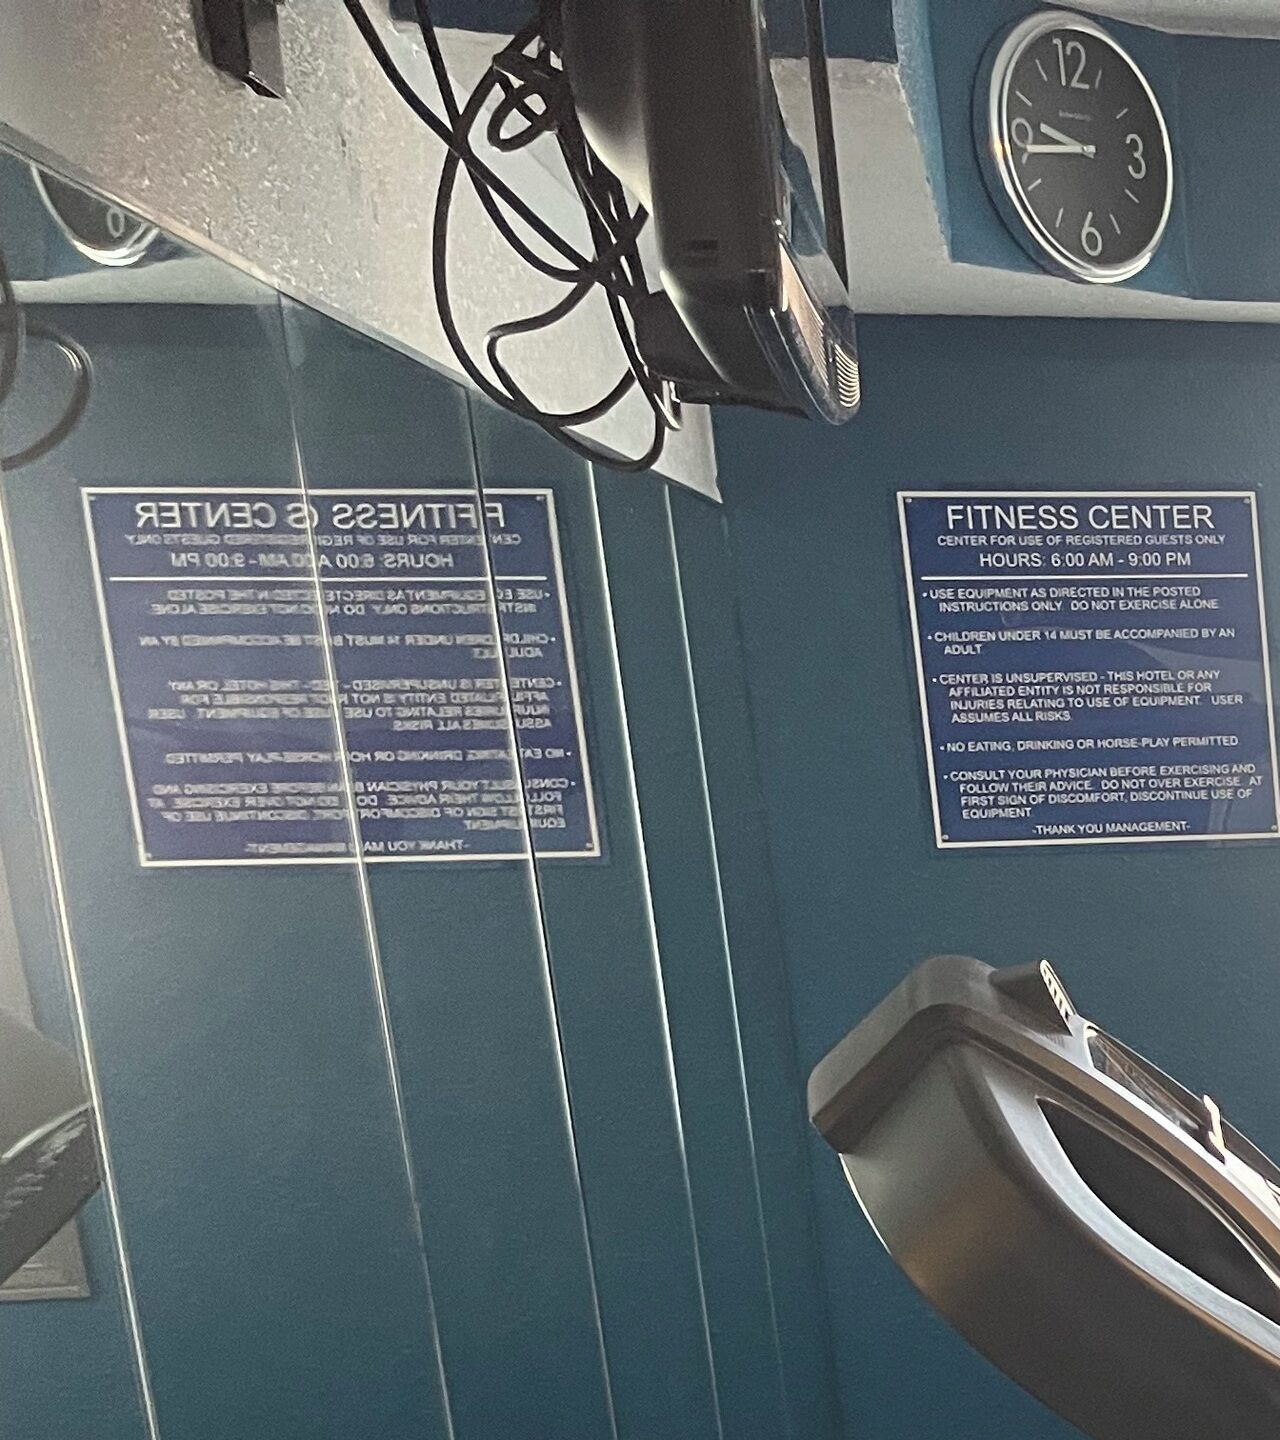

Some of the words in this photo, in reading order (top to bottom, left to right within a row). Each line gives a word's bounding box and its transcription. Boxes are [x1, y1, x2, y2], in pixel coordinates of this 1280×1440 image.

[1052, 37, 1090, 90] 12
[1011, 117, 1034, 165] 9
[1125, 133, 1147, 179] 3
[1080, 211, 1103, 257] 6
[945, 504, 1079, 530] FITNESS
[1086, 504, 1215, 529] CENTER
[936, 535, 988, 546] CENTER
[989, 534, 1016, 546] FOR
[1018, 534, 1044, 546] USE
[1045, 534, 1064, 545] OF
[1064, 534, 1143, 545] REGISTERED
[1144, 534, 1193, 545] GUESTS
[1194, 534, 1226, 545] ONLY
[978, 552, 1047, 567] HOURS:
[1049, 552, 1085, 567] 6:00
[1086, 552, 1114, 567] AM
[1127, 551, 1162, 566] 9:00
[1164, 551, 1192, 566] PM
[928, 588, 955, 599] USE
[956, 587, 1029, 598] EQUIPMENT
[1029, 587, 1047, 598] AS
[1048, 586, 1110, 597] DIRECTED
[1111, 586, 1125, 597] IN
[1126, 586, 1150, 597] THE
[1152, 585, 1201, 596] POSTED
[938, 600, 1029, 612] INSTRUCTIONS
[1070, 600, 1089, 610] DO
[1090, 599, 1117, 610] NOT
[1118, 599, 1177, 610] EXERCISE
[933, 630, 995, 642] CHILDREN
[998, 630, 1041, 641] UNDER
[1043, 629, 1057, 640] 14
[1058, 629, 1094, 640] MUST
[1094, 629, 1112, 640] BE
[1112, 628, 1199, 639] ACCOMPANIED
[1200, 627, 1217, 638] BY
[1217, 627, 1235, 638] AN
[943, 643, 983, 654] ADULT
[938, 673, 989, 685] CENTER
[990, 673, 1003, 684] IS
[1004, 671, 1097, 683] UNSUPERVISED
[1106, 670, 1134, 682] THIS
[1135, 670, 1175, 681] HOTEL
[1176, 669, 1195, 680] OR
[1195, 669, 1221, 680] ANY
[947, 685, 1016, 697] AFFILIATED
[1017, 684, 1060, 696] ENTITY
[1061, 684, 1074, 695] IS
[1075, 683, 1100, 695] NOT
[1102, 682, 1185, 694] RESPONSIBLE
[1186, 681, 1212, 693] FOR
[949, 698, 1005, 710] INJURIES
[1006, 697, 1066, 709] RELATING
[1067, 697, 1084, 708] TO
[1085, 696, 1110, 707] USE
[1112, 696, 1129, 707] OF
[1210, 693, 1244, 705] USER
[950, 711, 1010, 723] ASSUMES
[1010, 711, 1033, 722] ALL
[946, 742, 966, 753] NO
[966, 740, 1015, 754] EATING,
[1016, 739, 1074, 751] DRINKING
[1075, 738, 1094, 749] OR
[1095, 737, 1170, 749] HORSE-PLAY
[949, 769, 1006, 782] CONSULT
[1007, 768, 1042, 780] YOUR
[1043, 766, 1107, 779] PHYSICIAN
[1109, 765, 1156, 777] BEFORE
[1159, 763, 1229, 776] EXERCISING
[1230, 762, 1256, 773] AND
[958, 782, 1010, 794] FOLLOW
[1011, 781, 1047, 793] THEIR
[1100, 779, 1119, 790] DO
[1120, 778, 1146, 789] NOT
[1147, 777, 1181, 788] OVER
[1248, 774, 1263, 785] AT
[960, 795, 995, 807] FIRST
[996, 794, 1027, 805] SIGN
[1028, 793, 1046, 804] OF
[1047, 791, 1128, 805] DISCOMFORT,
[1129, 789, 1208, 801] DISCONTINUE
[1210, 788, 1234, 799] USE
[1236, 787, 1253, 798] OF
[1077, 823, 1103, 834] YOU
